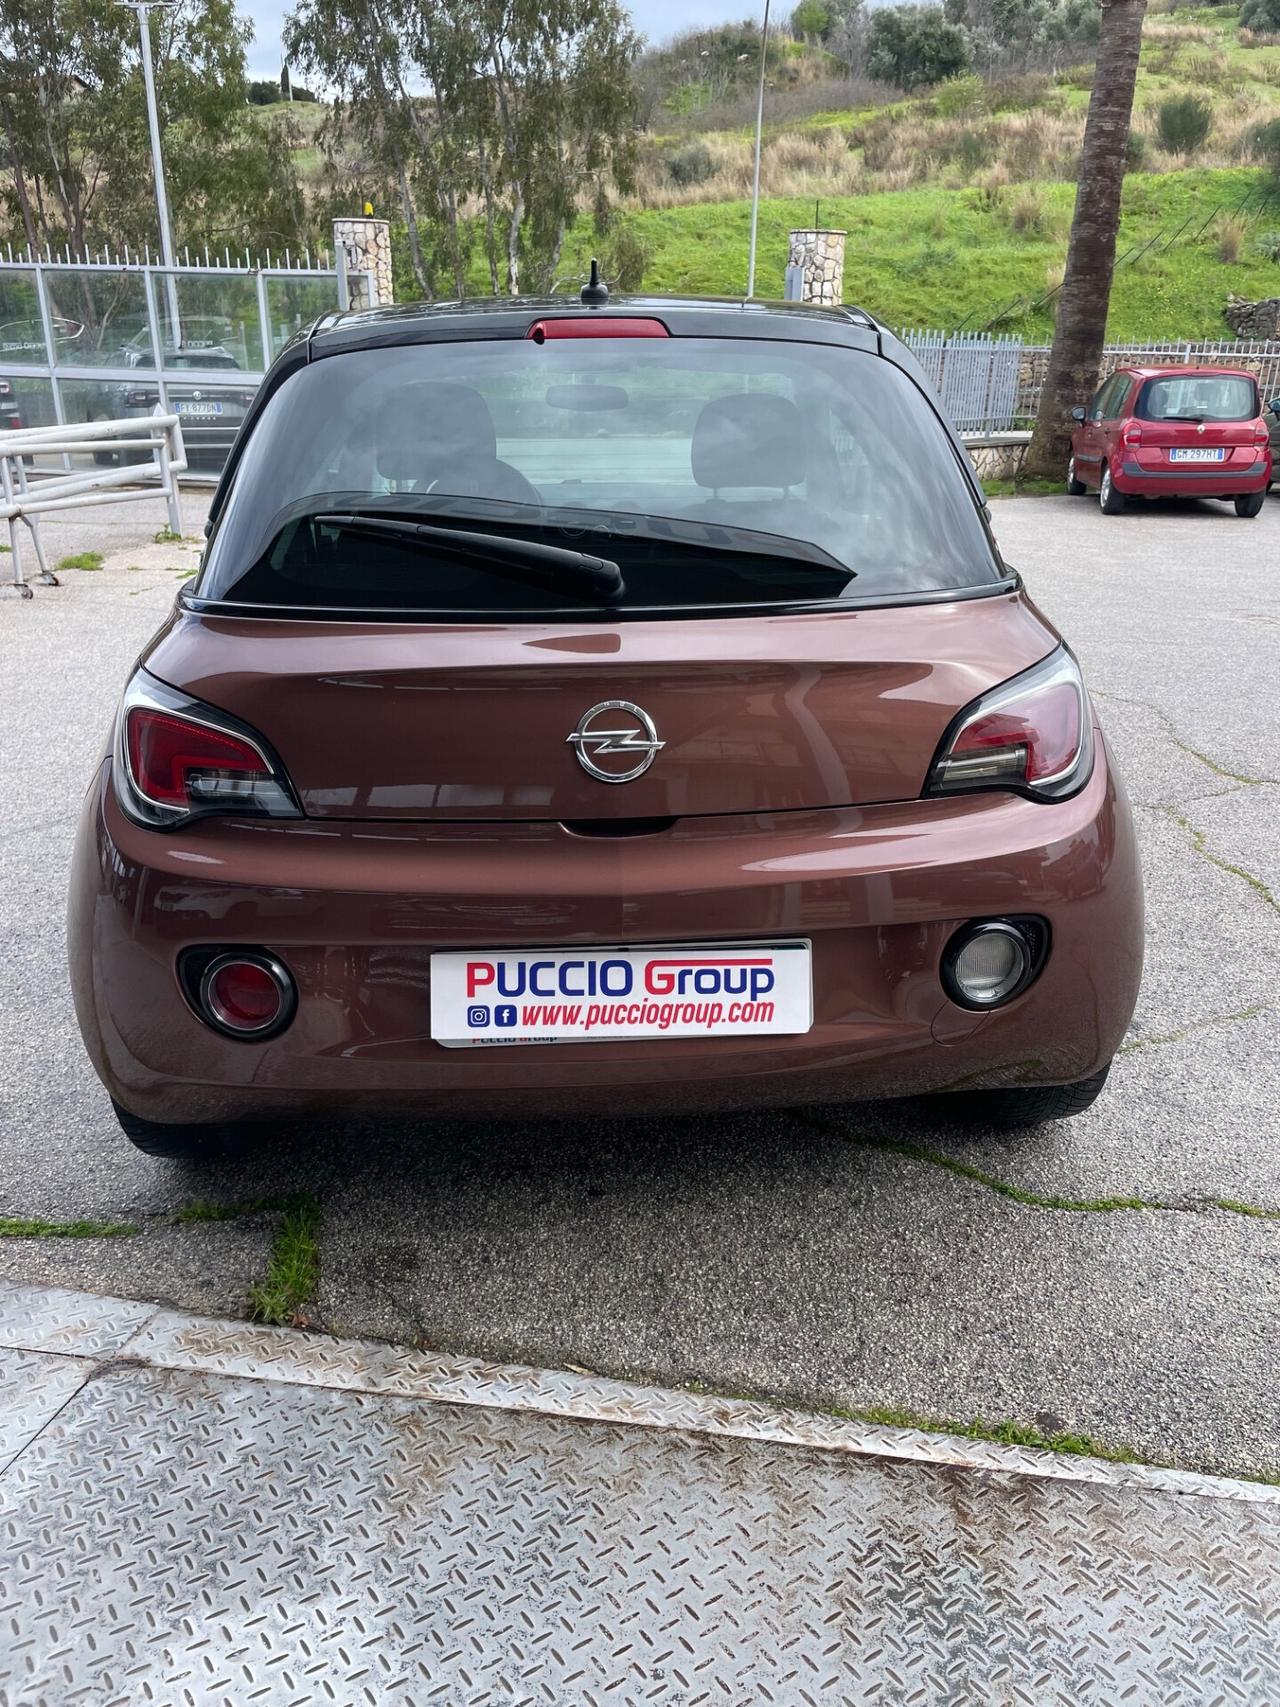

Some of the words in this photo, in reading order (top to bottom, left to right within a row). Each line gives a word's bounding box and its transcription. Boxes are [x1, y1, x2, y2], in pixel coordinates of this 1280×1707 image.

[1190, 449, 1217, 459] 297HT
[466, 959, 633, 998] PUCCIO
[521, 997, 775, 1031] www.pucciogroup.com
